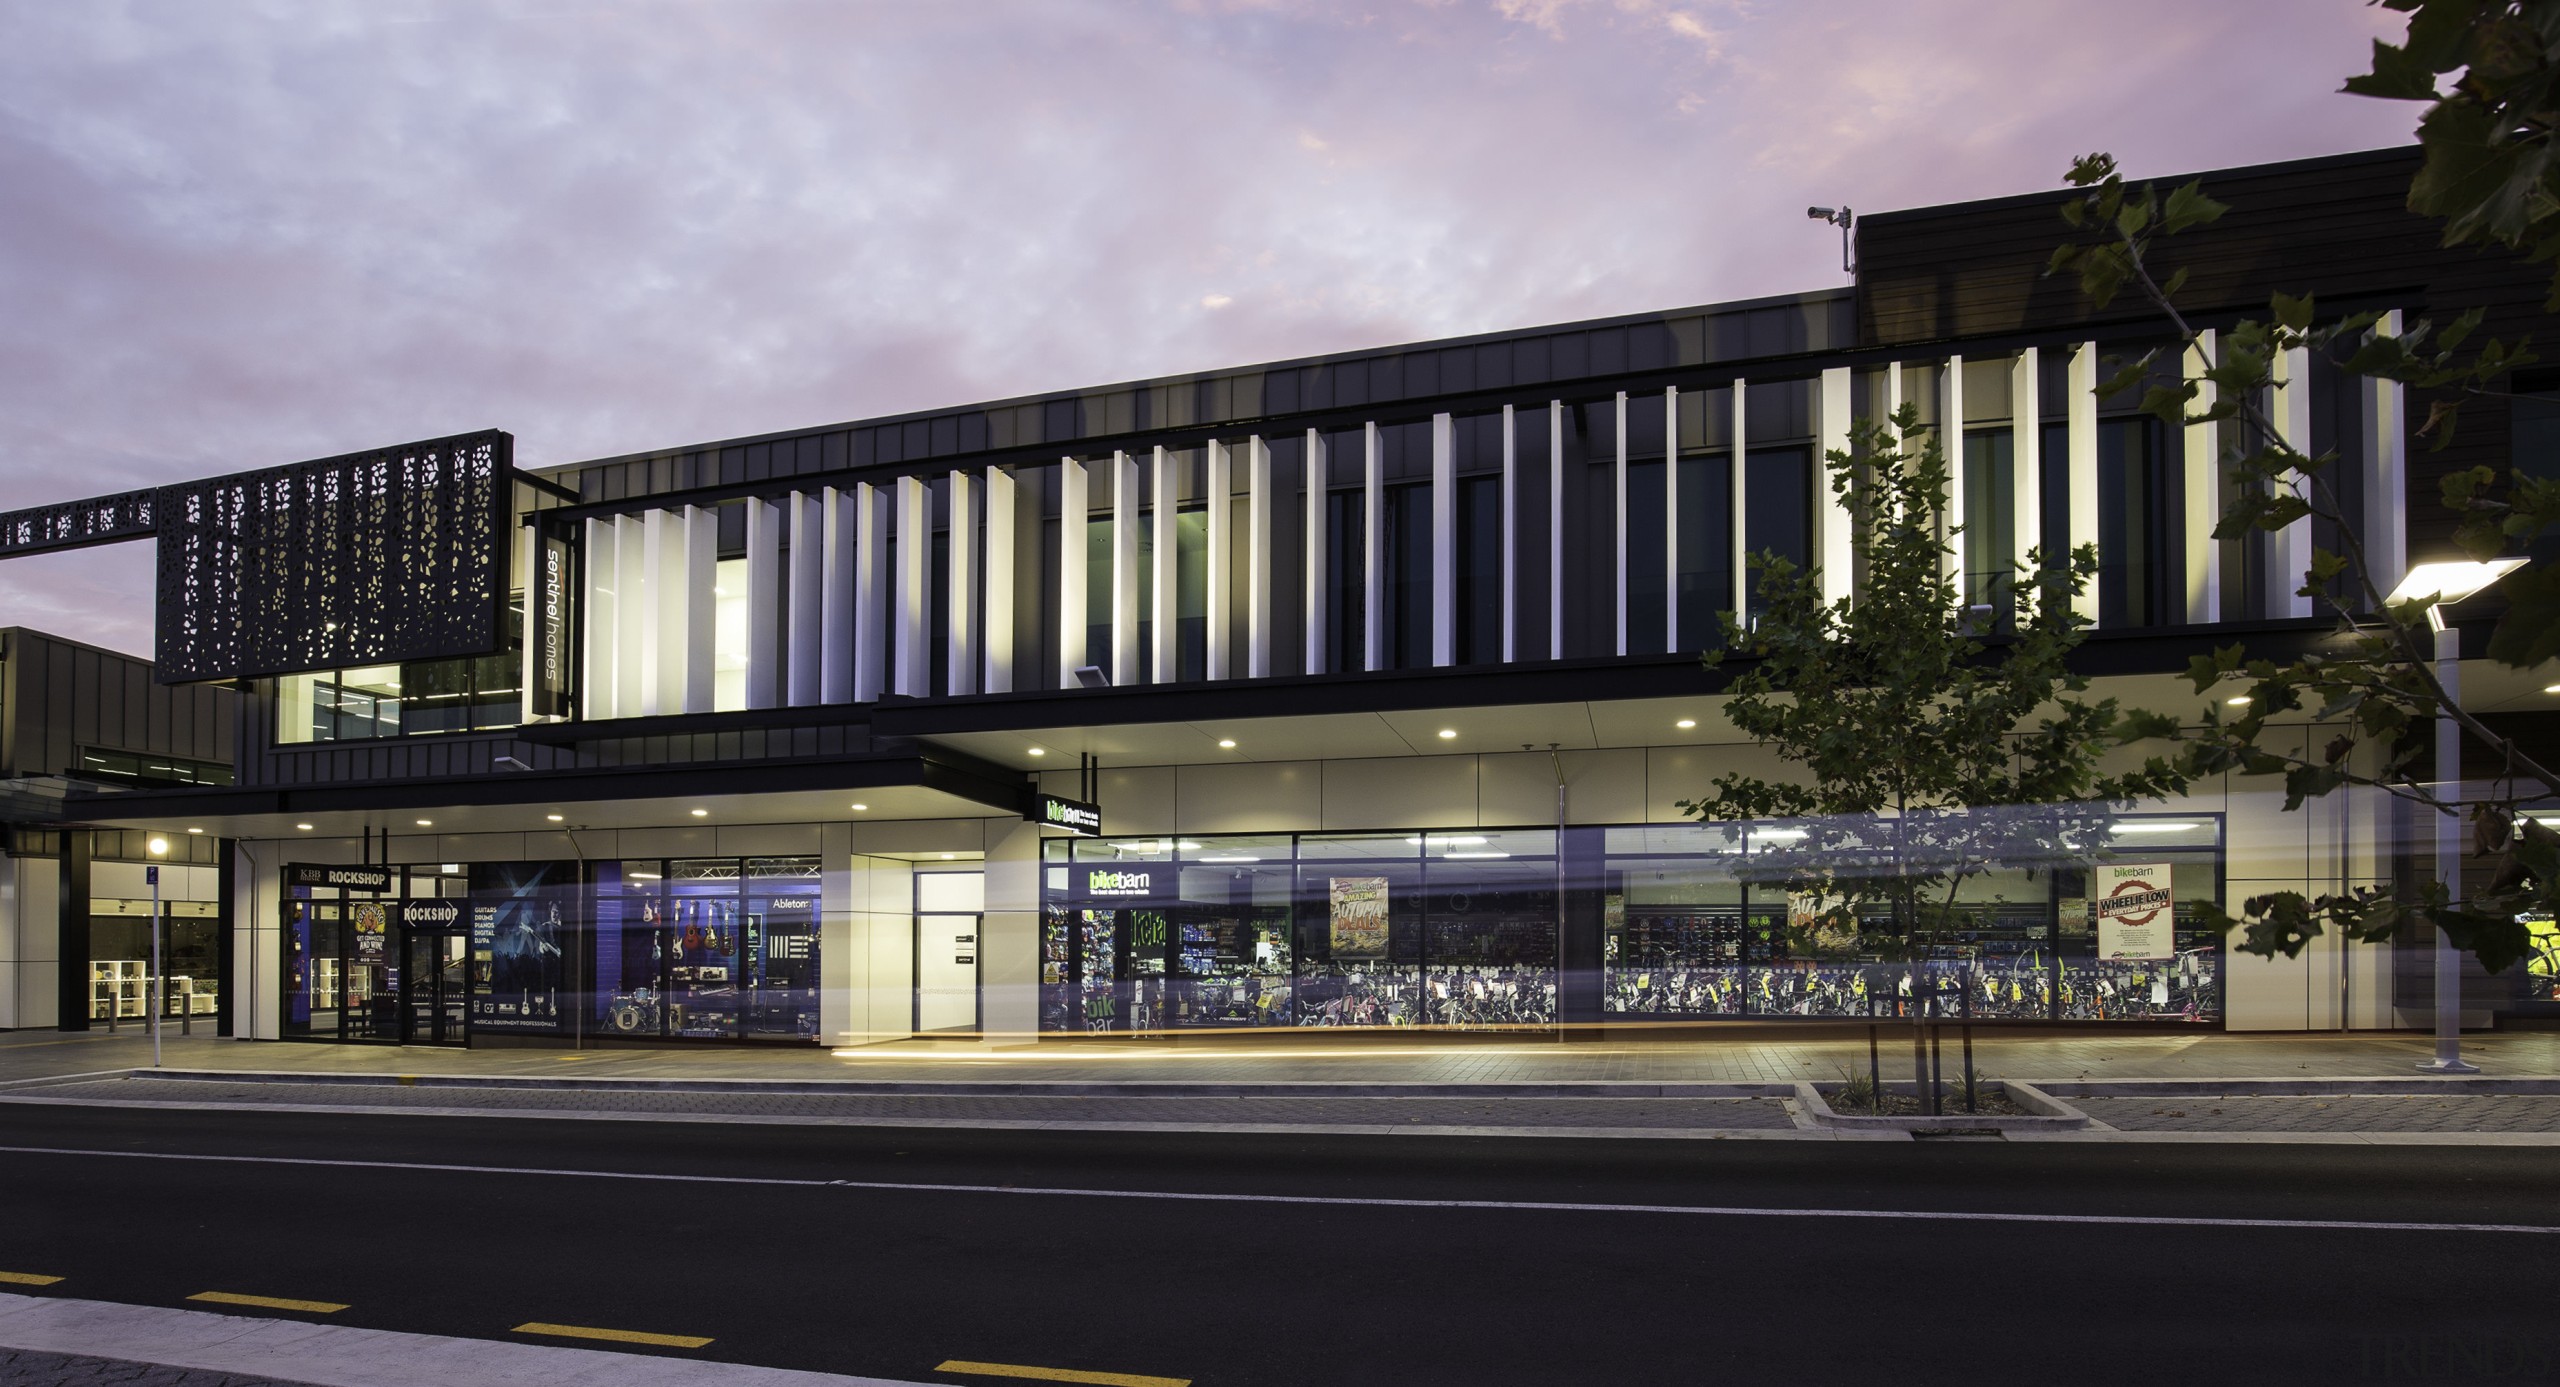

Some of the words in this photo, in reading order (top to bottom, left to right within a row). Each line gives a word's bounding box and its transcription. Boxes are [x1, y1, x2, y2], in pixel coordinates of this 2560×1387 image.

[300, 869, 321, 878] KBB
[328, 870, 386, 885] ROCKSHOP
[1089, 870, 1150, 889] bikebarn
[2114, 867, 2153, 877] bikebarn
[773, 899, 806, 909] Ableton
[1343, 892, 1376, 902] AMAZING
[2100, 894, 2144, 910] WHEELIE
[2146, 889, 2169, 902] LOW
[404, 907, 458, 920] ROCKSHOP
[1332, 898, 1386, 921] AUTUMN
[2108, 905, 2139, 916] EVERYDAY
[2140, 901, 2161, 911] PRICES
[1338, 915, 1382, 931] DEALS
